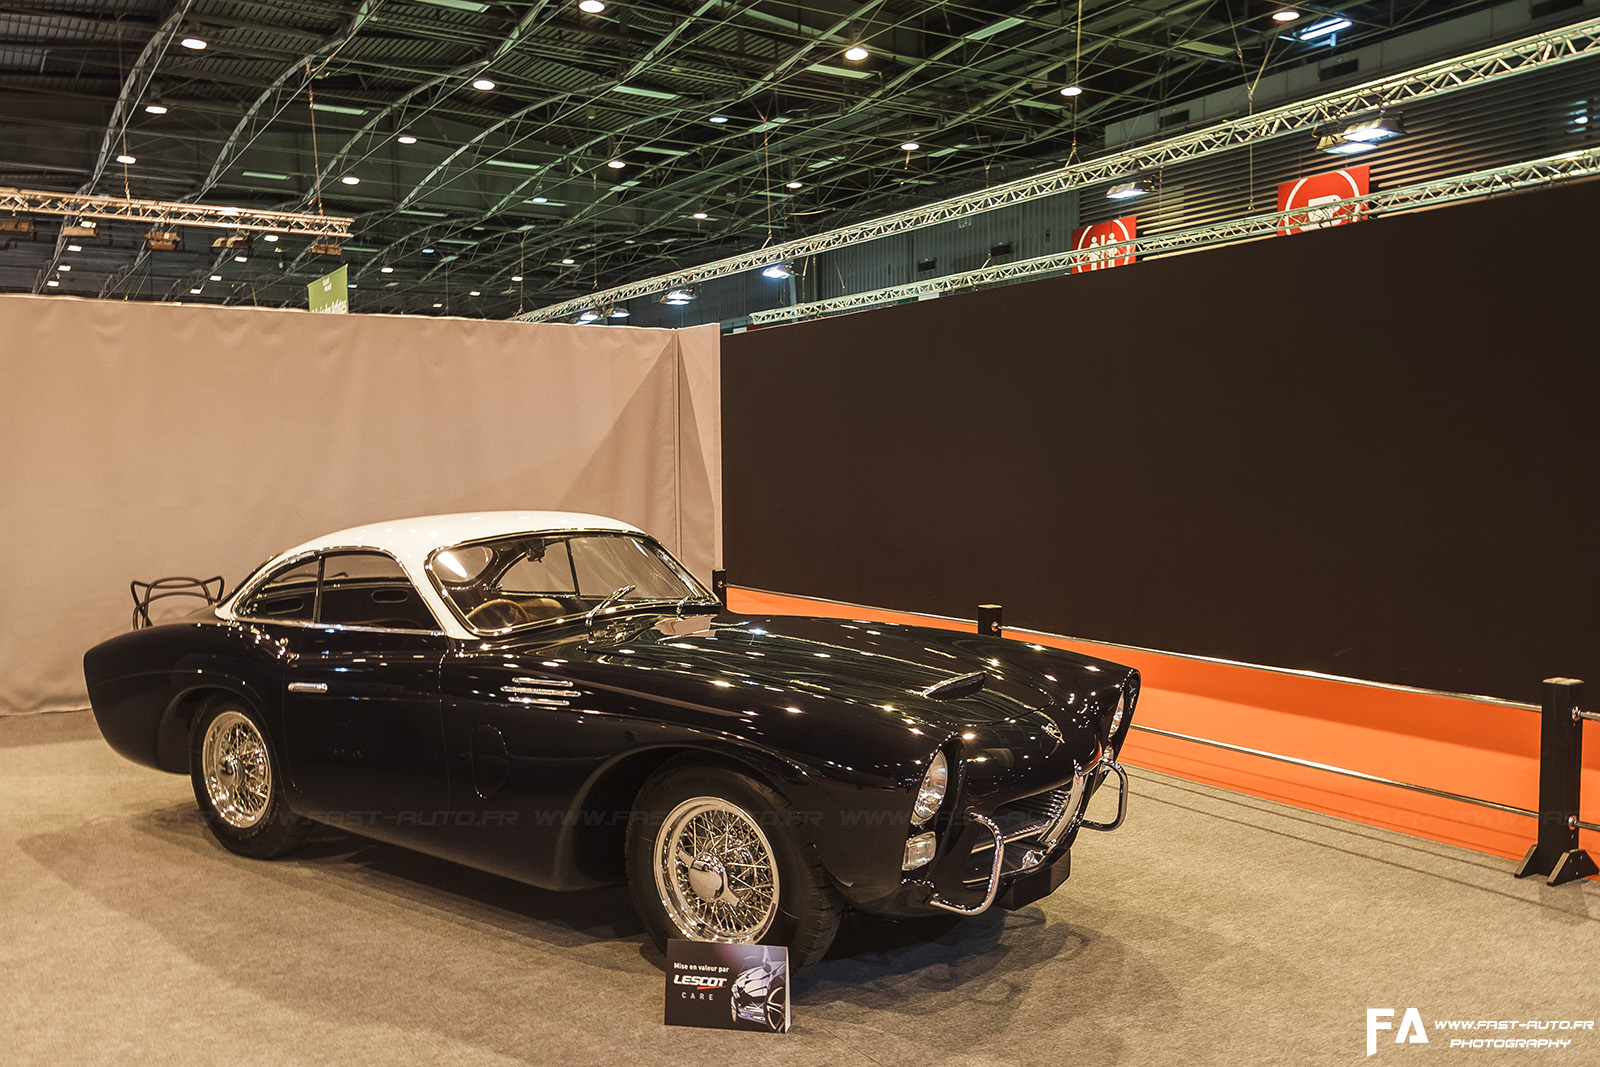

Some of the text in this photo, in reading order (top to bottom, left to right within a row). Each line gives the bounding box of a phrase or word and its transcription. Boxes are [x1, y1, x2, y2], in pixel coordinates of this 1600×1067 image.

[673, 962, 688, 970] Mise
[673, 974, 727, 986] LESCOT
[681, 991, 714, 1001] CARE
